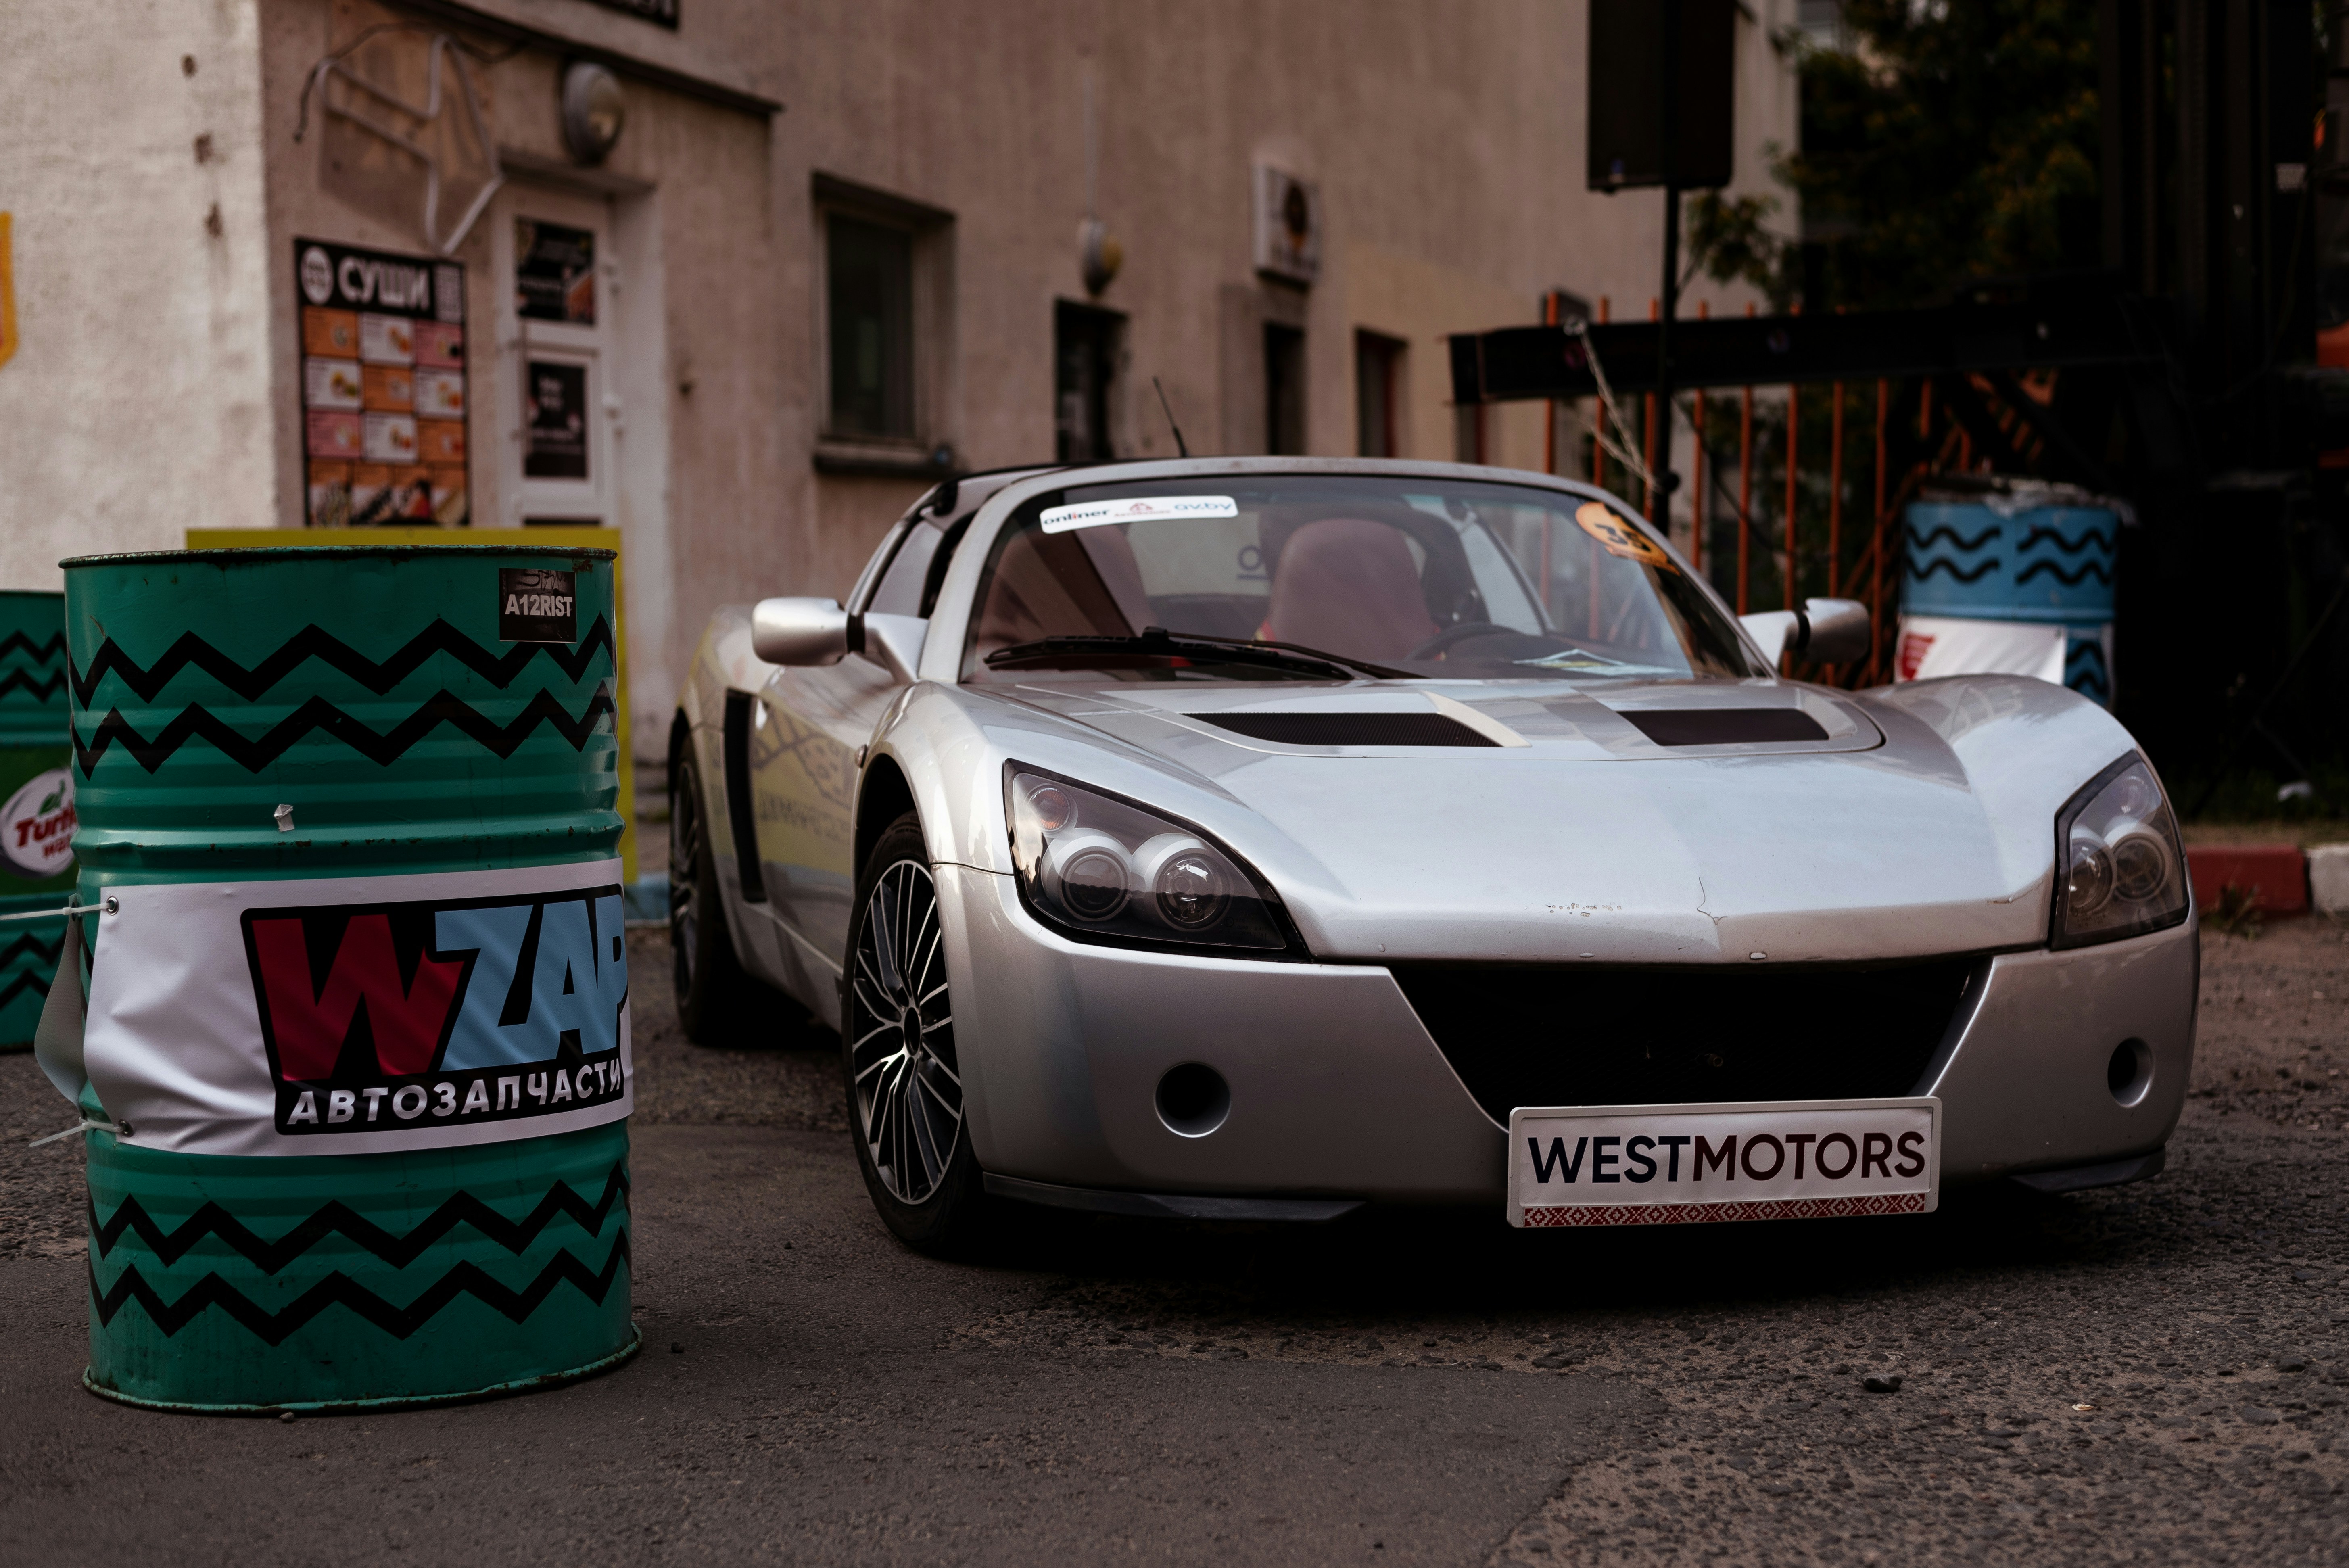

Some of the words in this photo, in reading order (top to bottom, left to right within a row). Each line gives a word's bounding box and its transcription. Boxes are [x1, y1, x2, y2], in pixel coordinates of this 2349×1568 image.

[338, 256, 430, 311] СУШИ
[1044, 509, 1110, 524] onliner
[1174, 501, 1232, 511] av.by
[505, 594, 572, 617] A12RIST
[251, 894, 628, 1081] WZAP
[287, 1058, 621, 1125] АВТОЗАПЧАСТИ
[1528, 1131, 1925, 1184] WESTMOTORS
